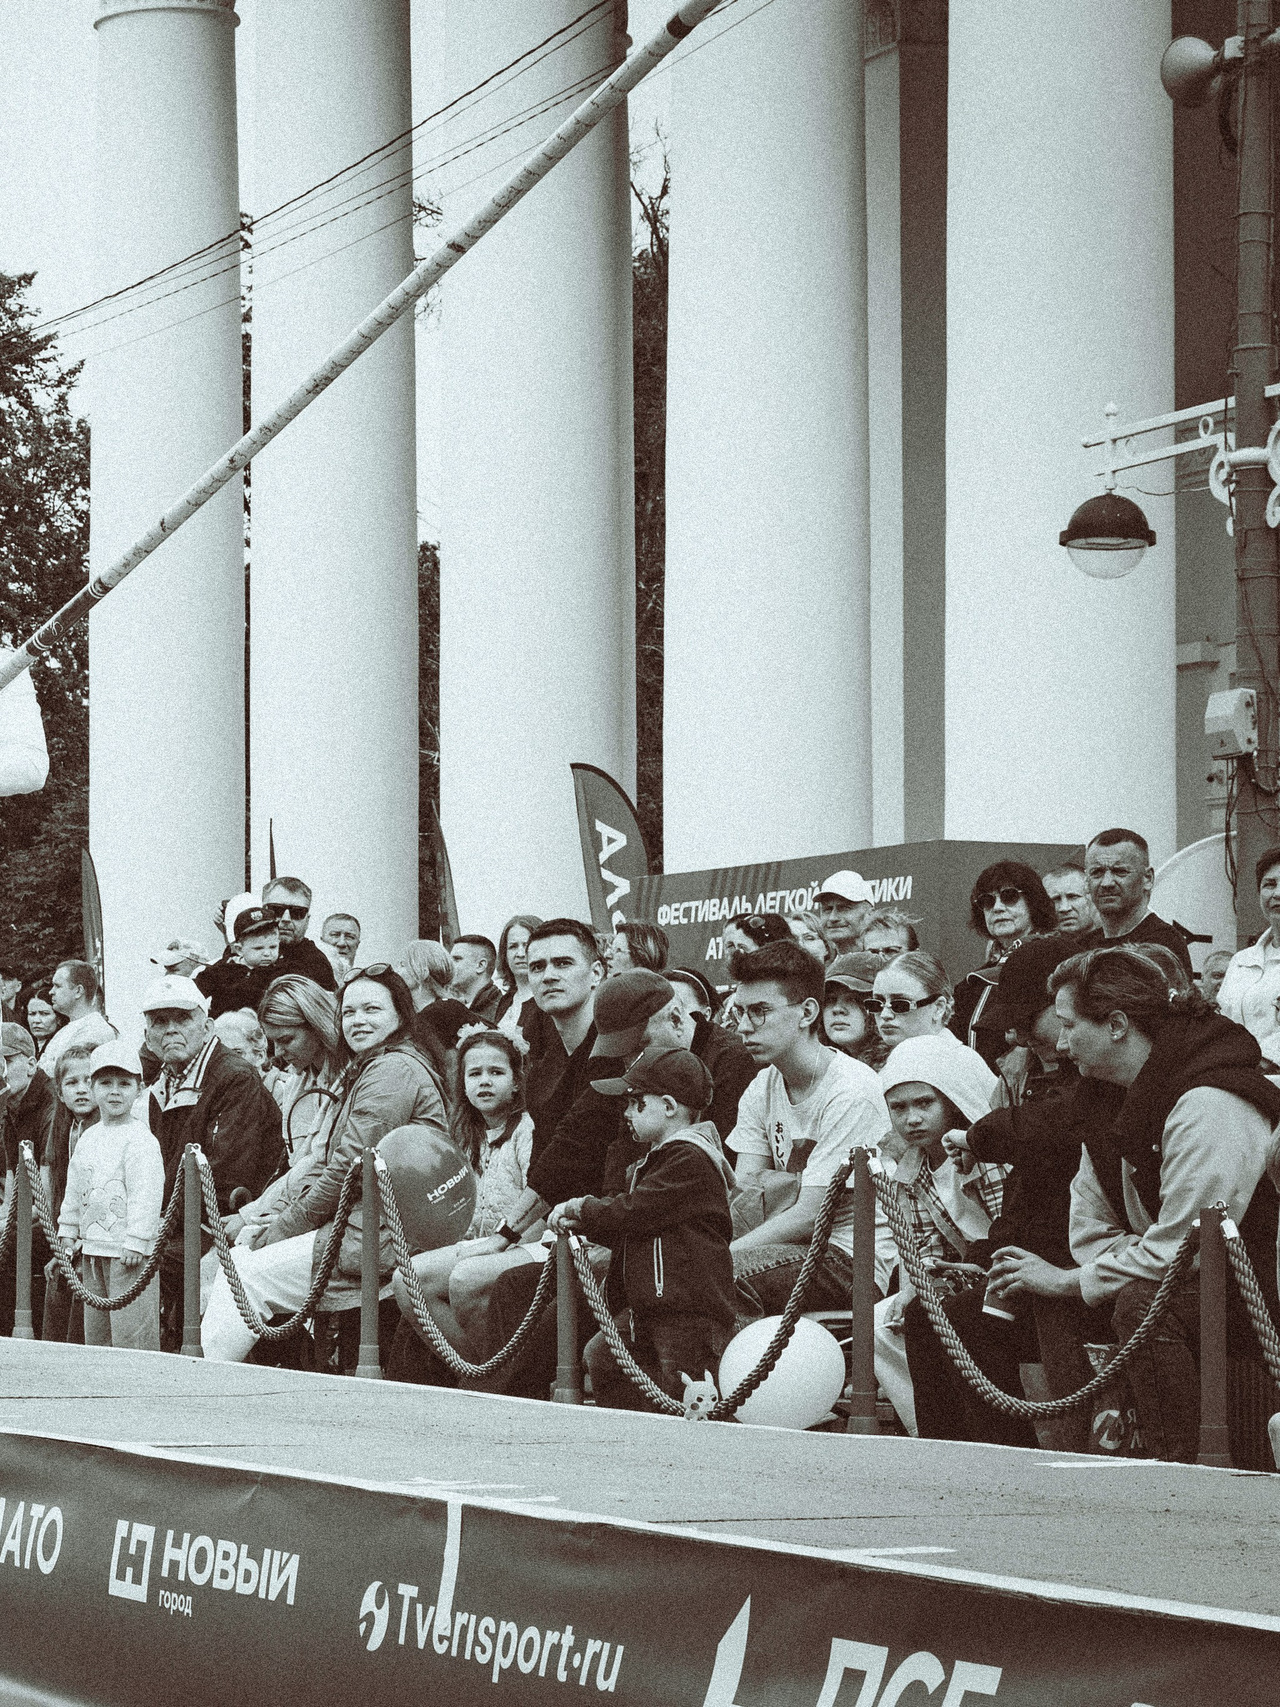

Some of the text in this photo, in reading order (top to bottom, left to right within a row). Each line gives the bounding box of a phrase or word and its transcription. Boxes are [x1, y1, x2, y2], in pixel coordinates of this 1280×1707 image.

[657, 895, 752, 926] ФЕСТИВАЛЬ
[426, 1165, 469, 1201] НОВЫЙ
[161, 1529, 300, 1605] НОВЫЙ
[159, 1590, 193, 1617] город
